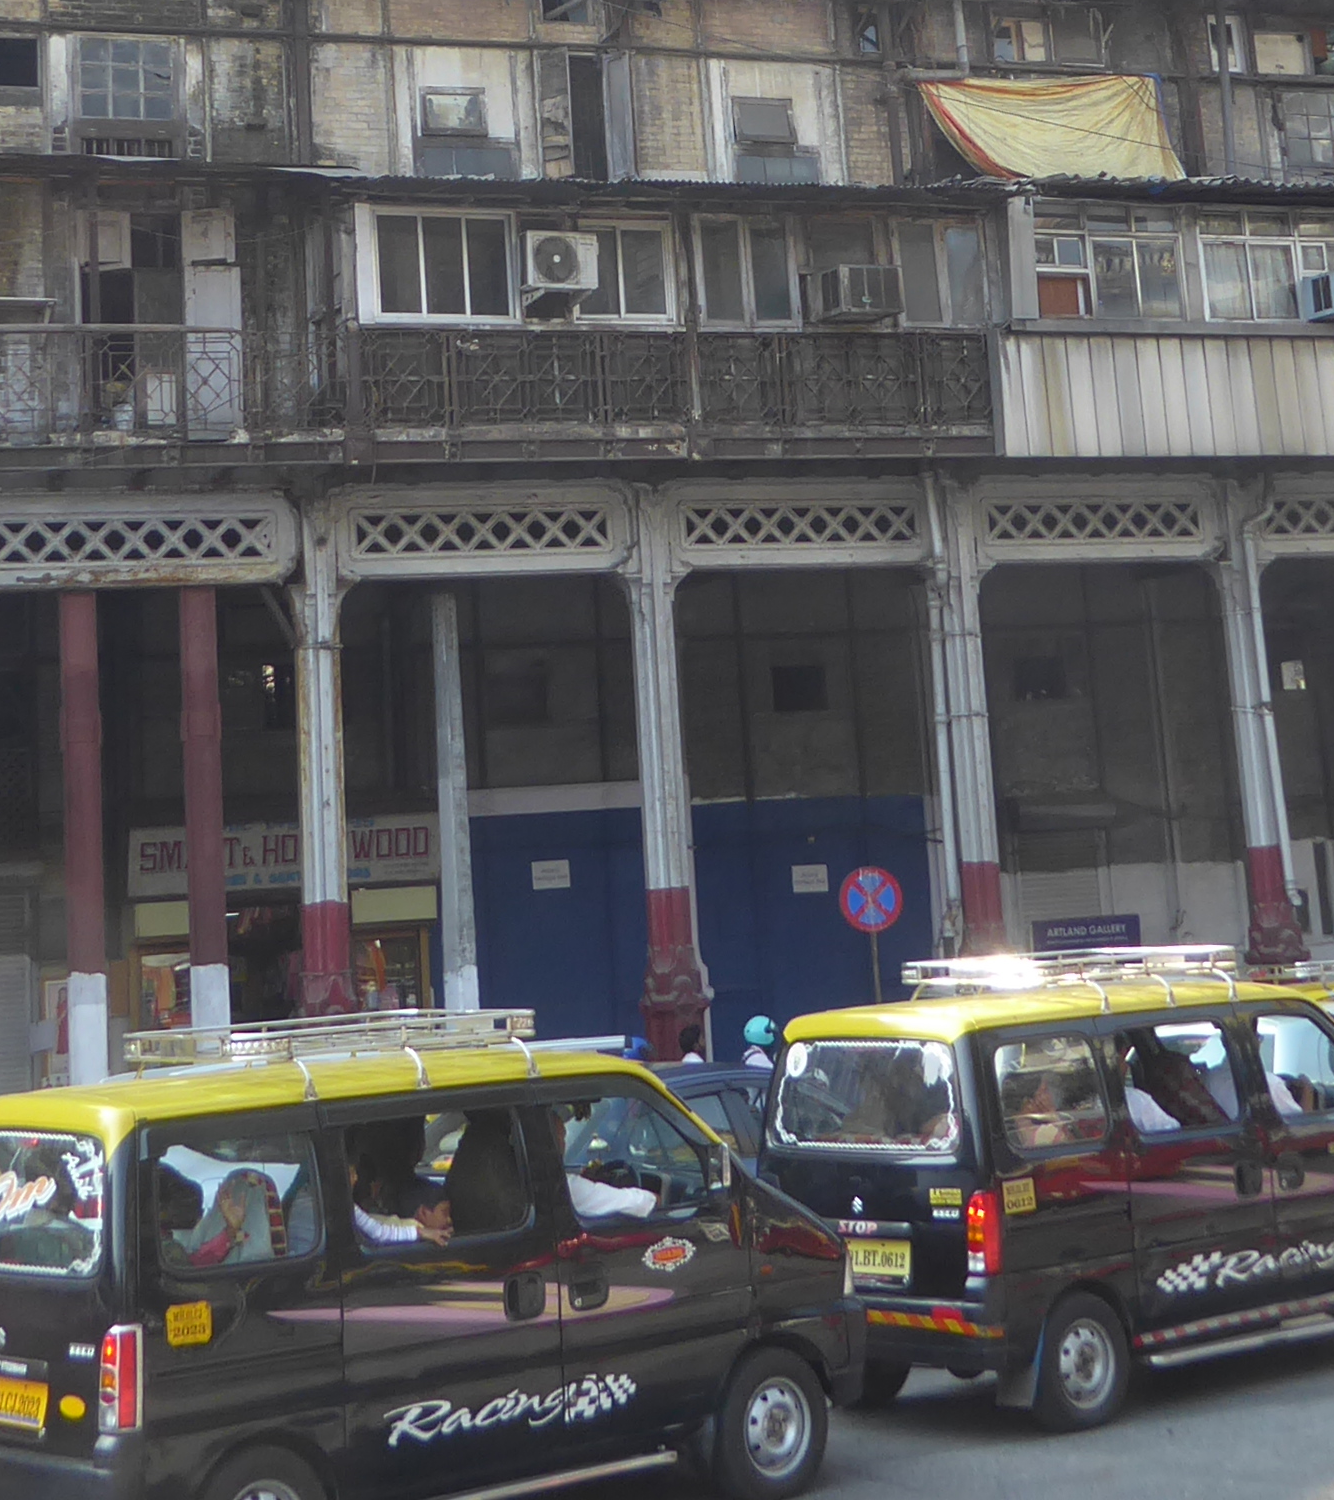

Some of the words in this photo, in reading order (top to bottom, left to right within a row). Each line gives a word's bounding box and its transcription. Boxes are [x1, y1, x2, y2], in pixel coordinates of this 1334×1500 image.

[837, 1219, 878, 1235] STOP
[851, 1248, 907, 1270] 1.BT.0612
[173, 1322, 207, 1338] 2023
[383, 1388, 571, 1447] Racing
